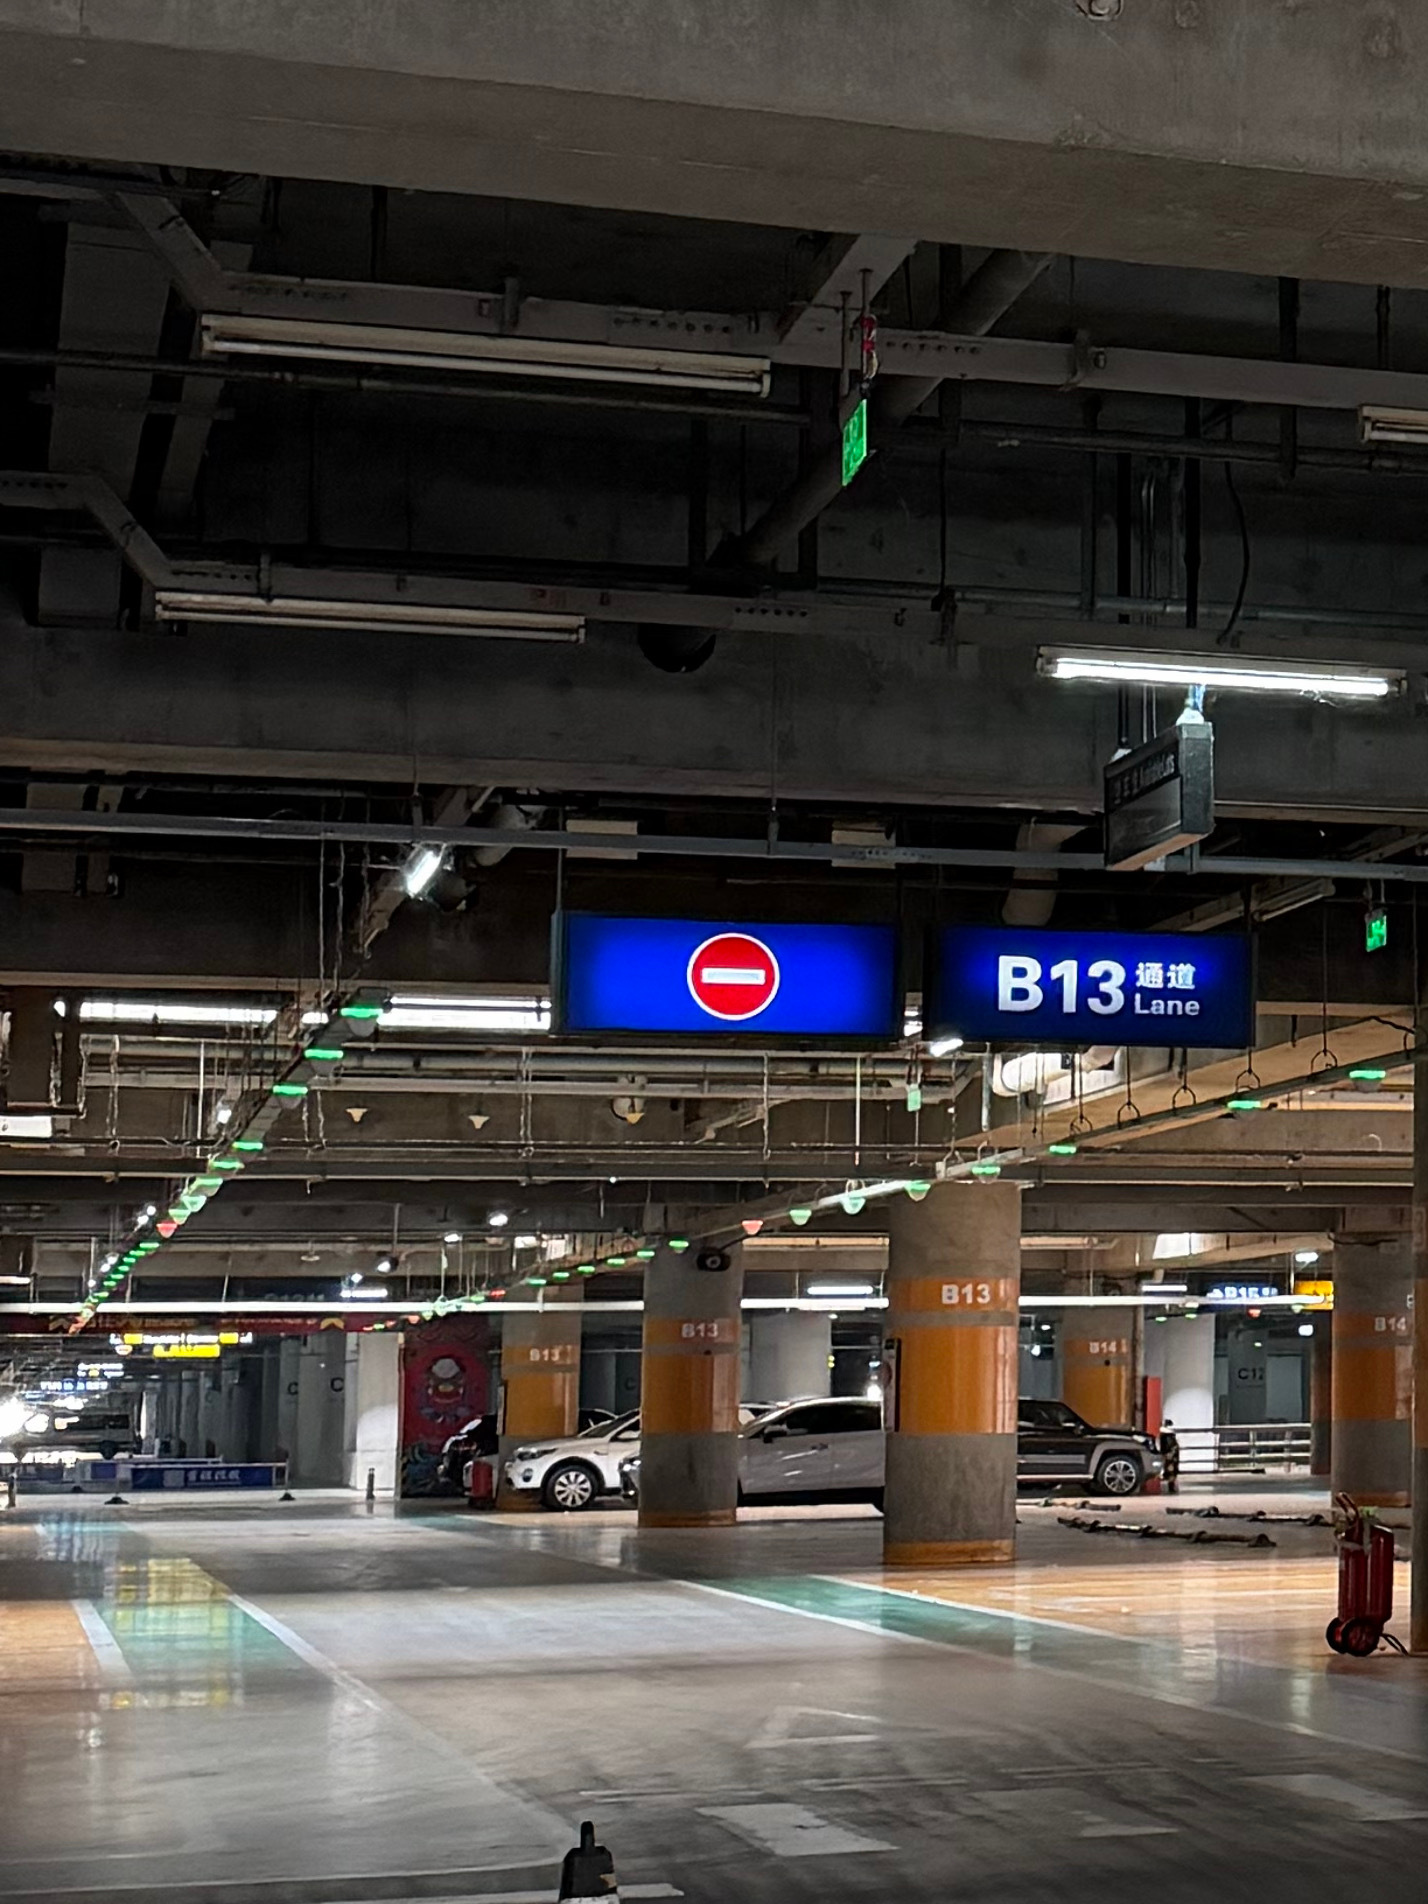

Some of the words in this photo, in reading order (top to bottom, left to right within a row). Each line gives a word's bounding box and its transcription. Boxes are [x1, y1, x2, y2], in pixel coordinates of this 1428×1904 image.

[998, 954, 1126, 1015] B13
[1136, 961, 1197, 990] 通道
[1135, 992, 1201, 1016] Lane
[940, 1282, 992, 1305] B13
[681, 1322, 719, 1338] B13
[1374, 1317, 1407, 1332] B14
